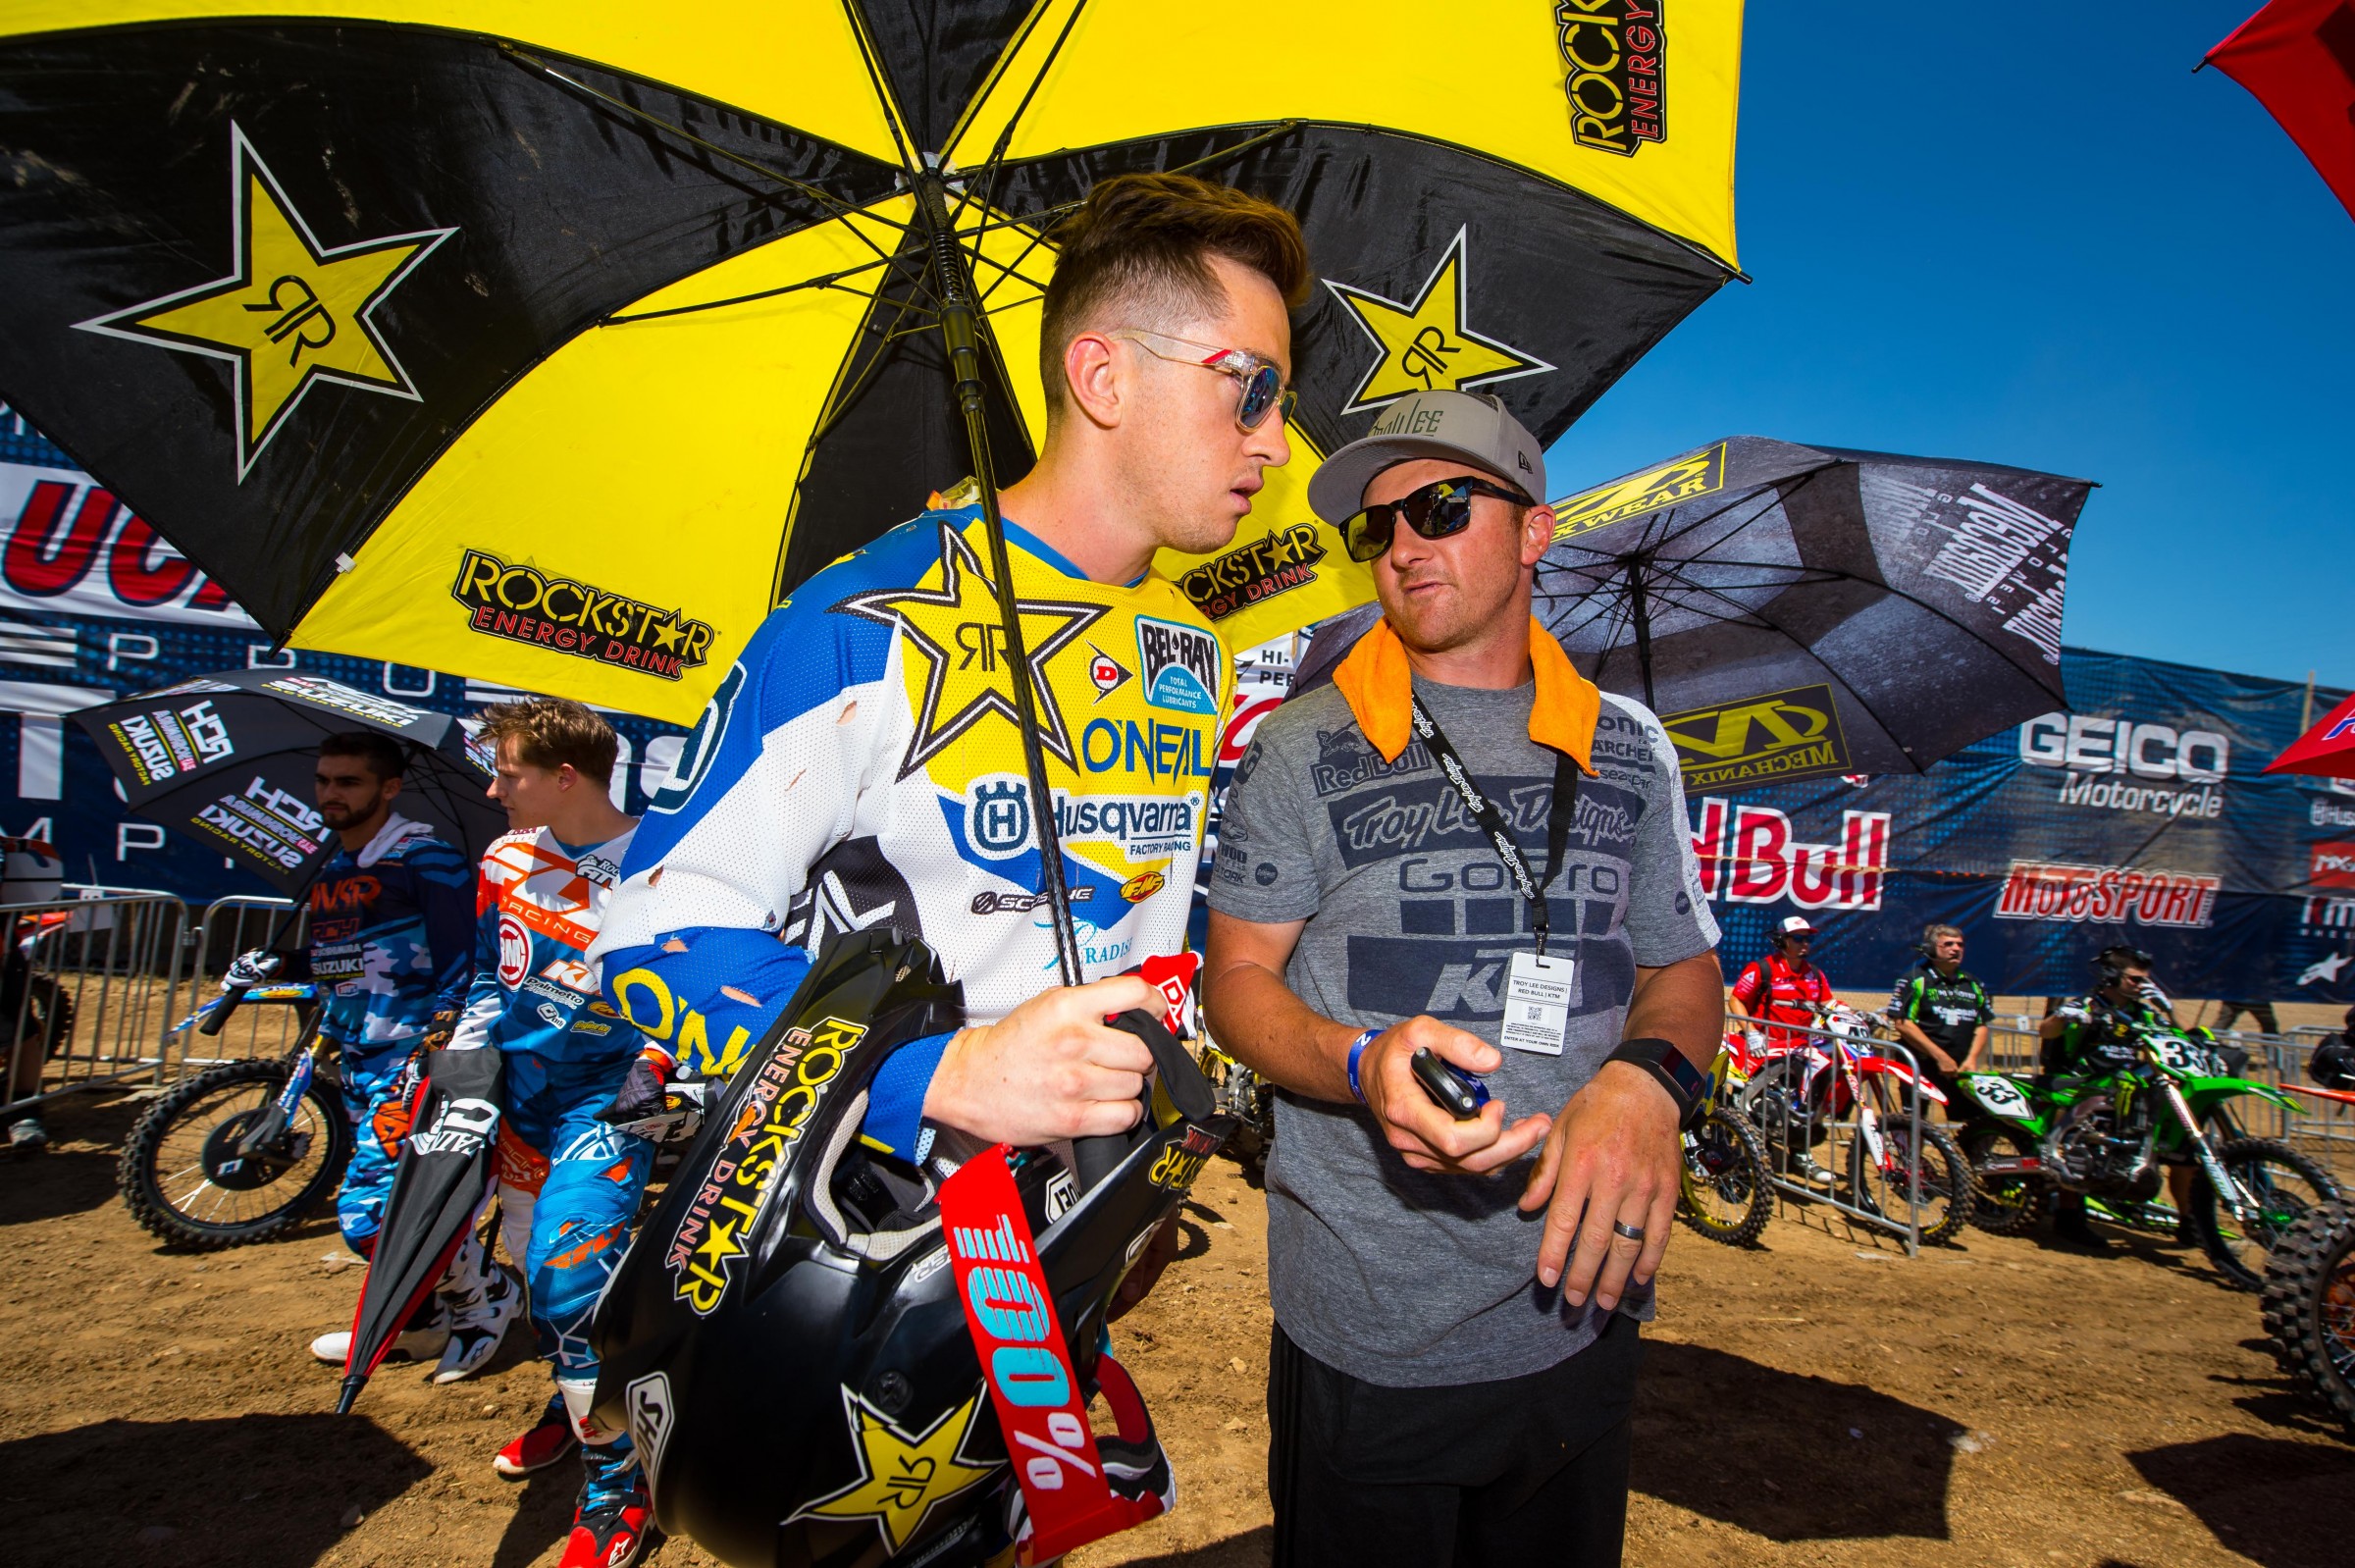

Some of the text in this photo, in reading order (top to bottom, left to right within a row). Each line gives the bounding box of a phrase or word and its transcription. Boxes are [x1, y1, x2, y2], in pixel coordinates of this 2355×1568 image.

[1245, 562, 1313, 601] DRINK
[475, 604, 684, 676] ENERGY DRINK
[1261, 649, 1289, 664] HI-
[2019, 711, 2228, 784] GEICO
[2059, 771, 2224, 821] Motorcycle
[1129, 840, 1165, 855] FACTORY
[1724, 805, 1892, 911] Bull
[1540, 984, 1565, 993] DESIGNS
[668, 1158, 737, 1271] DRINK
